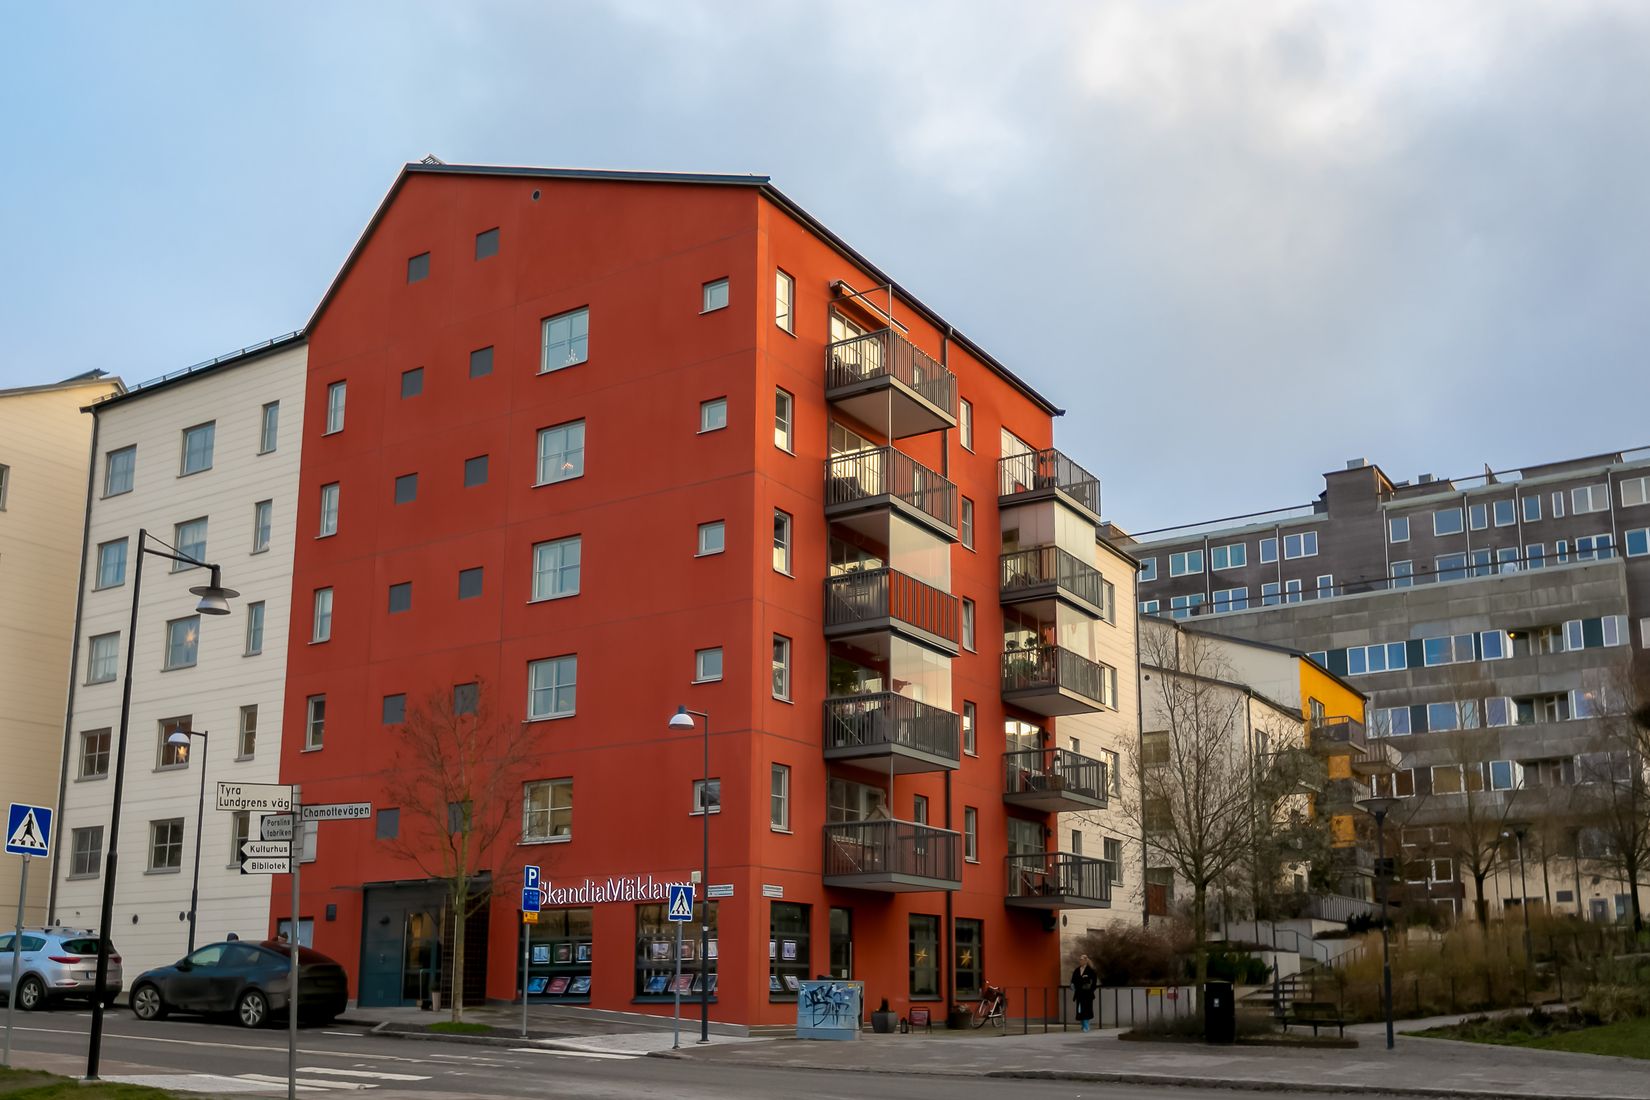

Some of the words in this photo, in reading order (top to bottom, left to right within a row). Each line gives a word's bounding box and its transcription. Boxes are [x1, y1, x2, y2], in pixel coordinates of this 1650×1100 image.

[220, 785, 241, 797] Tyra
[219, 797, 268, 809] Lundgrens
[271, 798, 290, 810] väg
[303, 805, 370, 818] Chamottevägen
[266, 829, 292, 838] fabriken
[250, 845, 288, 853] Kulturhus
[251, 861, 287, 870] Bibliotek
[528, 868, 537, 886] P
